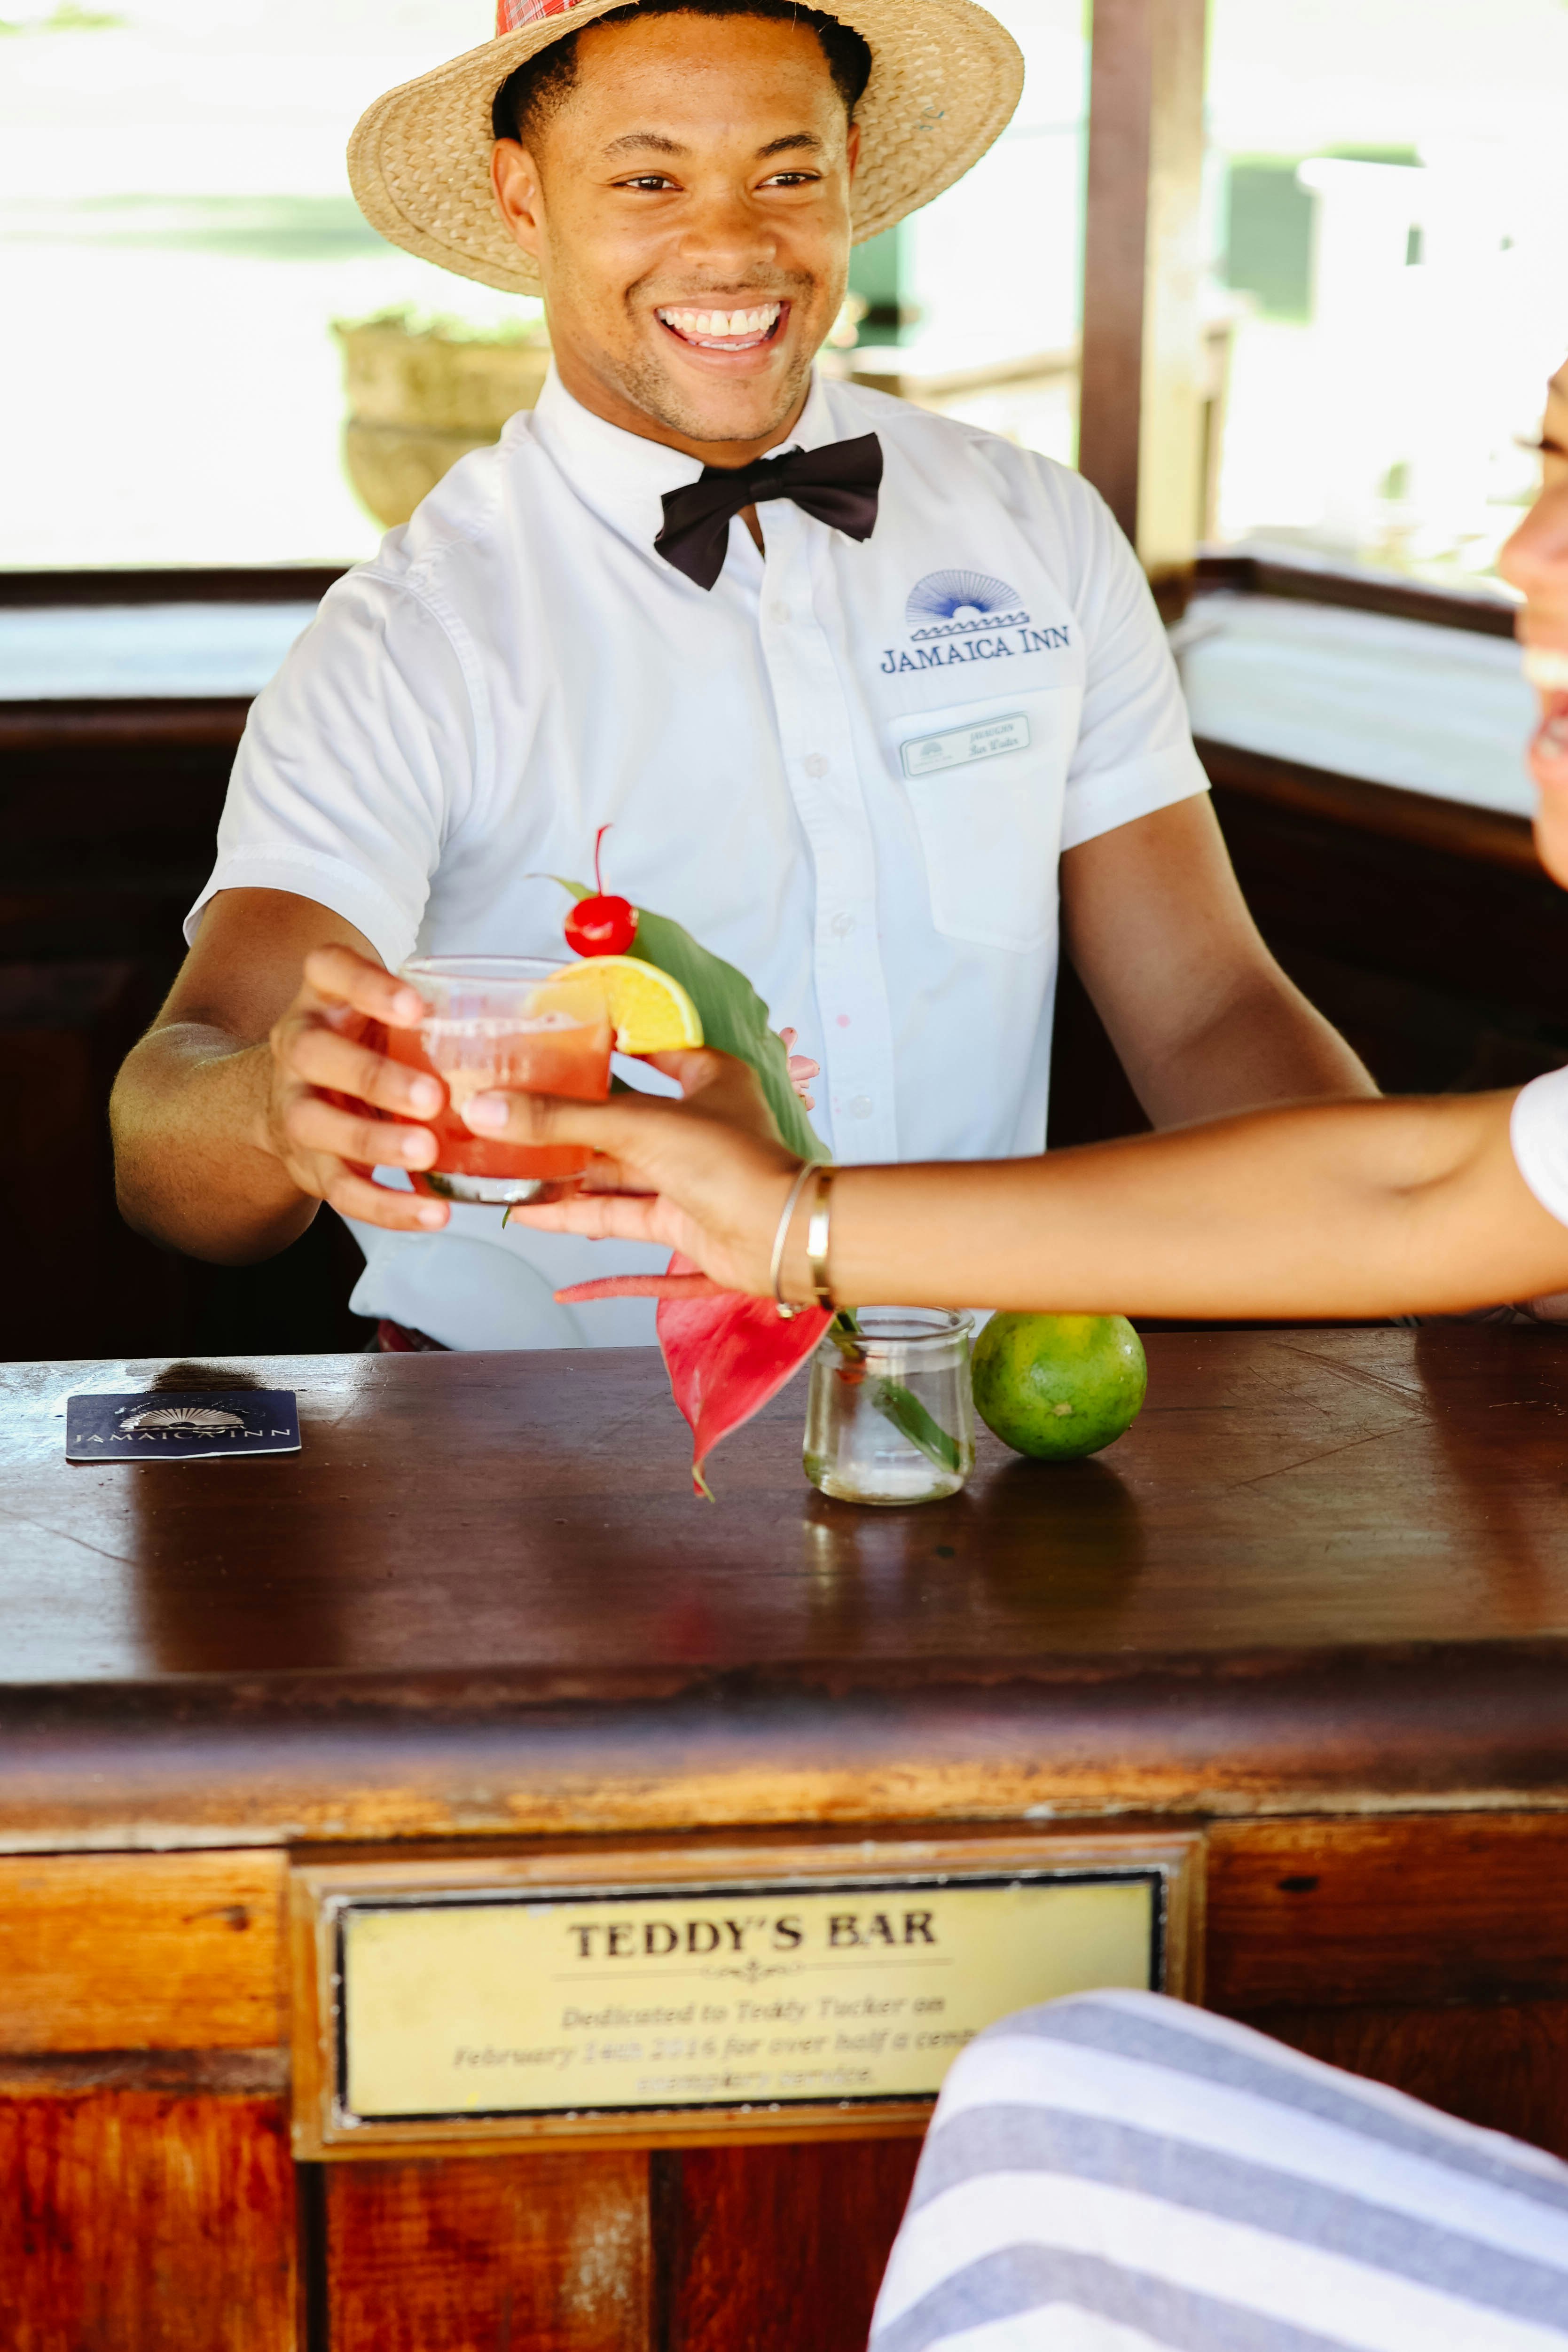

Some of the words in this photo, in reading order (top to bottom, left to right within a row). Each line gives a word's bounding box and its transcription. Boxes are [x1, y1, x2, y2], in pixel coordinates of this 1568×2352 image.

[881, 637, 1015, 674] JAMAICA
[1018, 625, 1071, 654] INN
[229, 1429, 290, 1438] INN
[568, 1915, 804, 1959] TEDDY'S
[828, 1909, 937, 1949] BAR
[700, 2004, 729, 2022] to
[737, 1999, 808, 2023] Teddy
[452, 2045, 575, 2070] February
[722, 2034, 762, 2060] for
